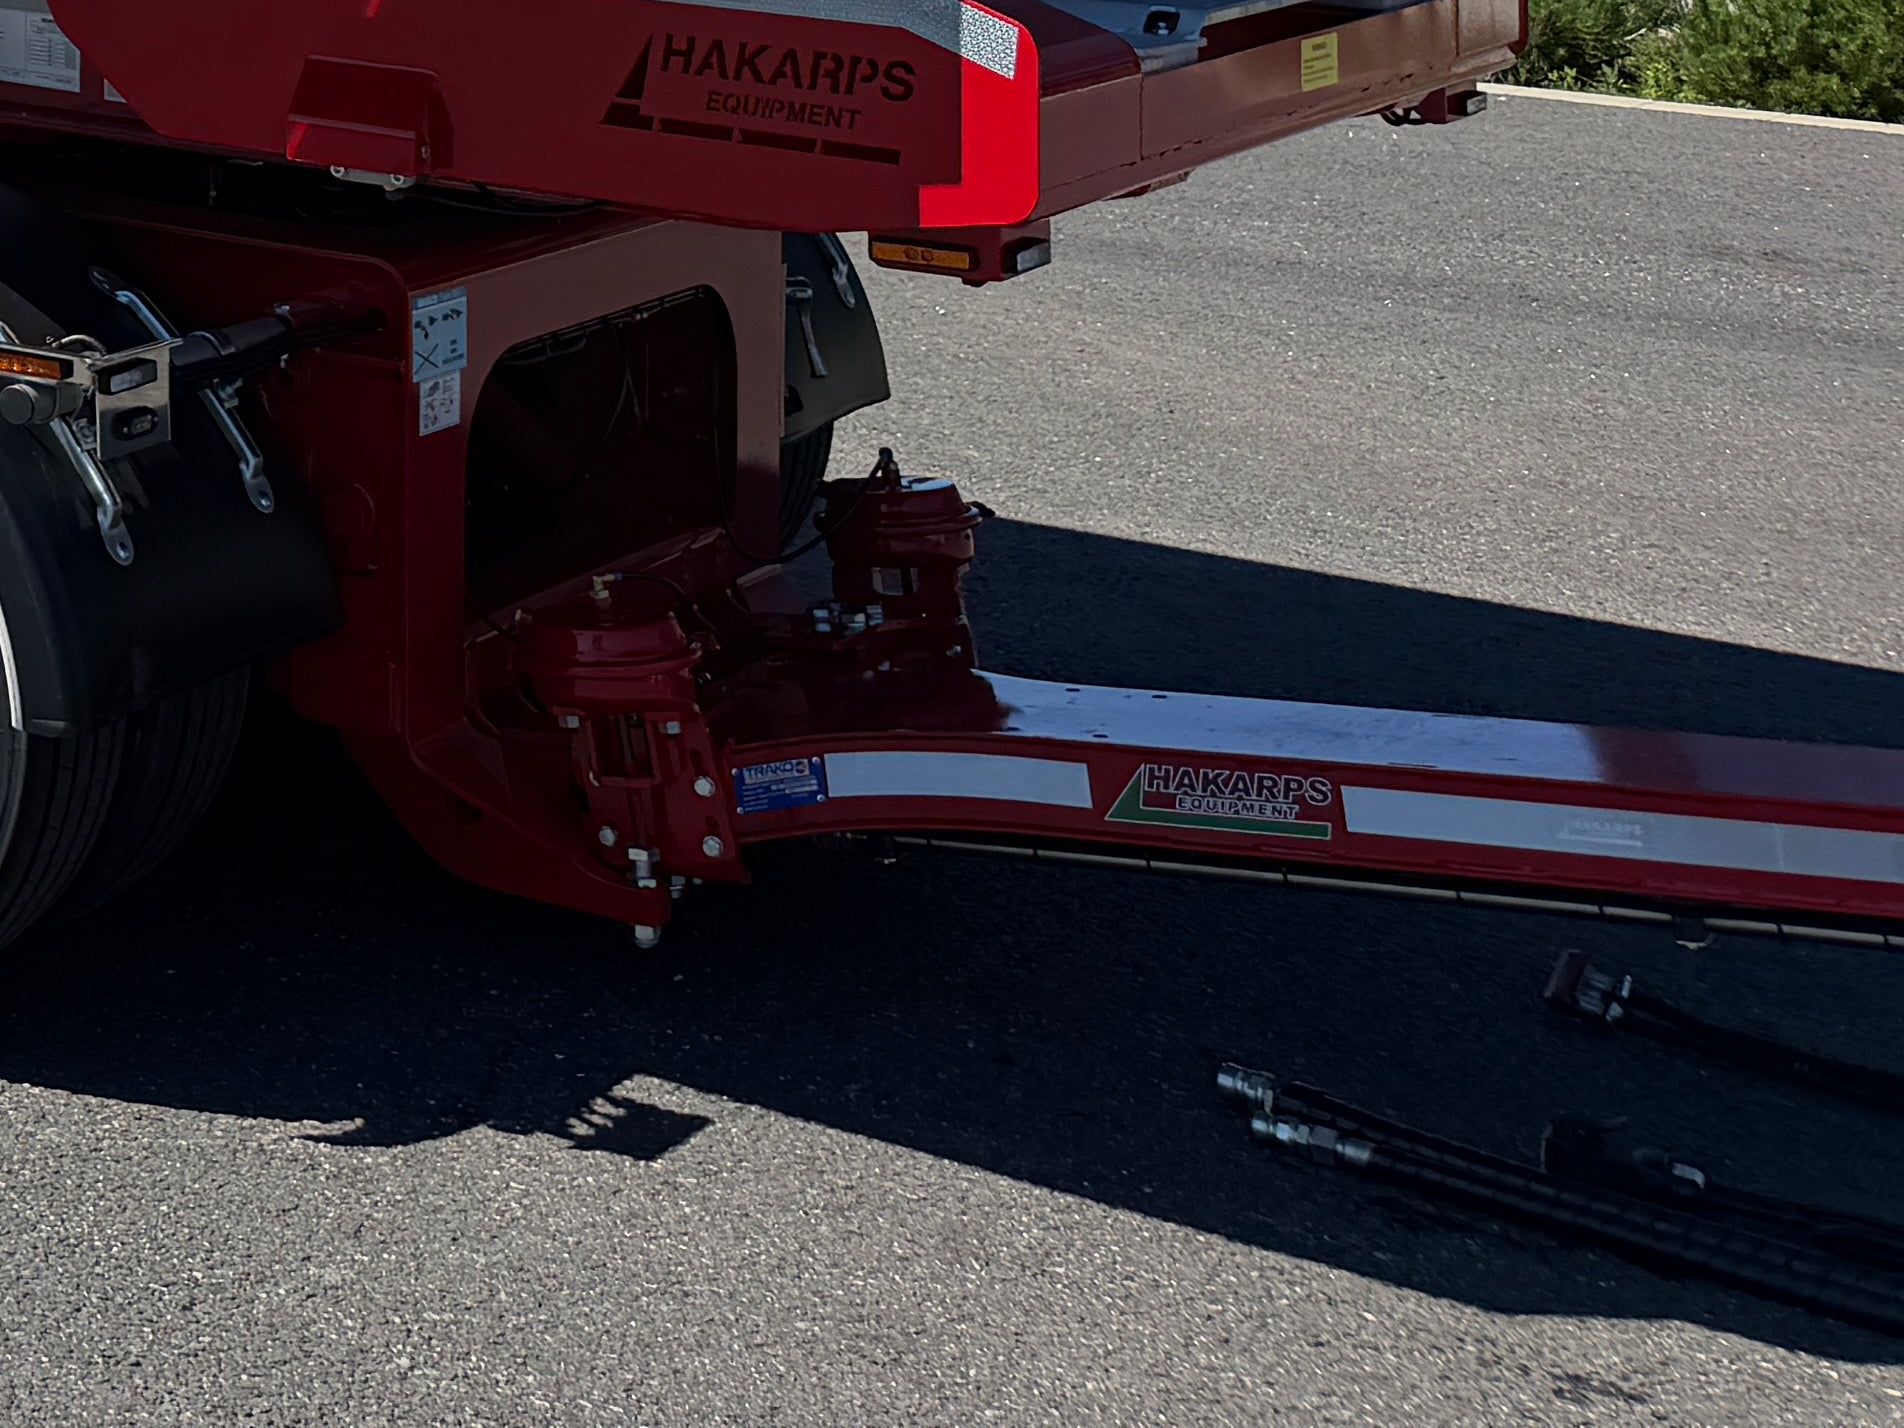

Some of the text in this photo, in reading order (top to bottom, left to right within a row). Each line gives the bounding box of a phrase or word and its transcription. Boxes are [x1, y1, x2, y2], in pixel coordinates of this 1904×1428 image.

[659, 32, 917, 102] HAKARPS
[704, 90, 862, 131] EQUIPMENT
[1144, 763, 1333, 806] HAKARPS
[1176, 795, 1299, 820] EQUIPMENT
